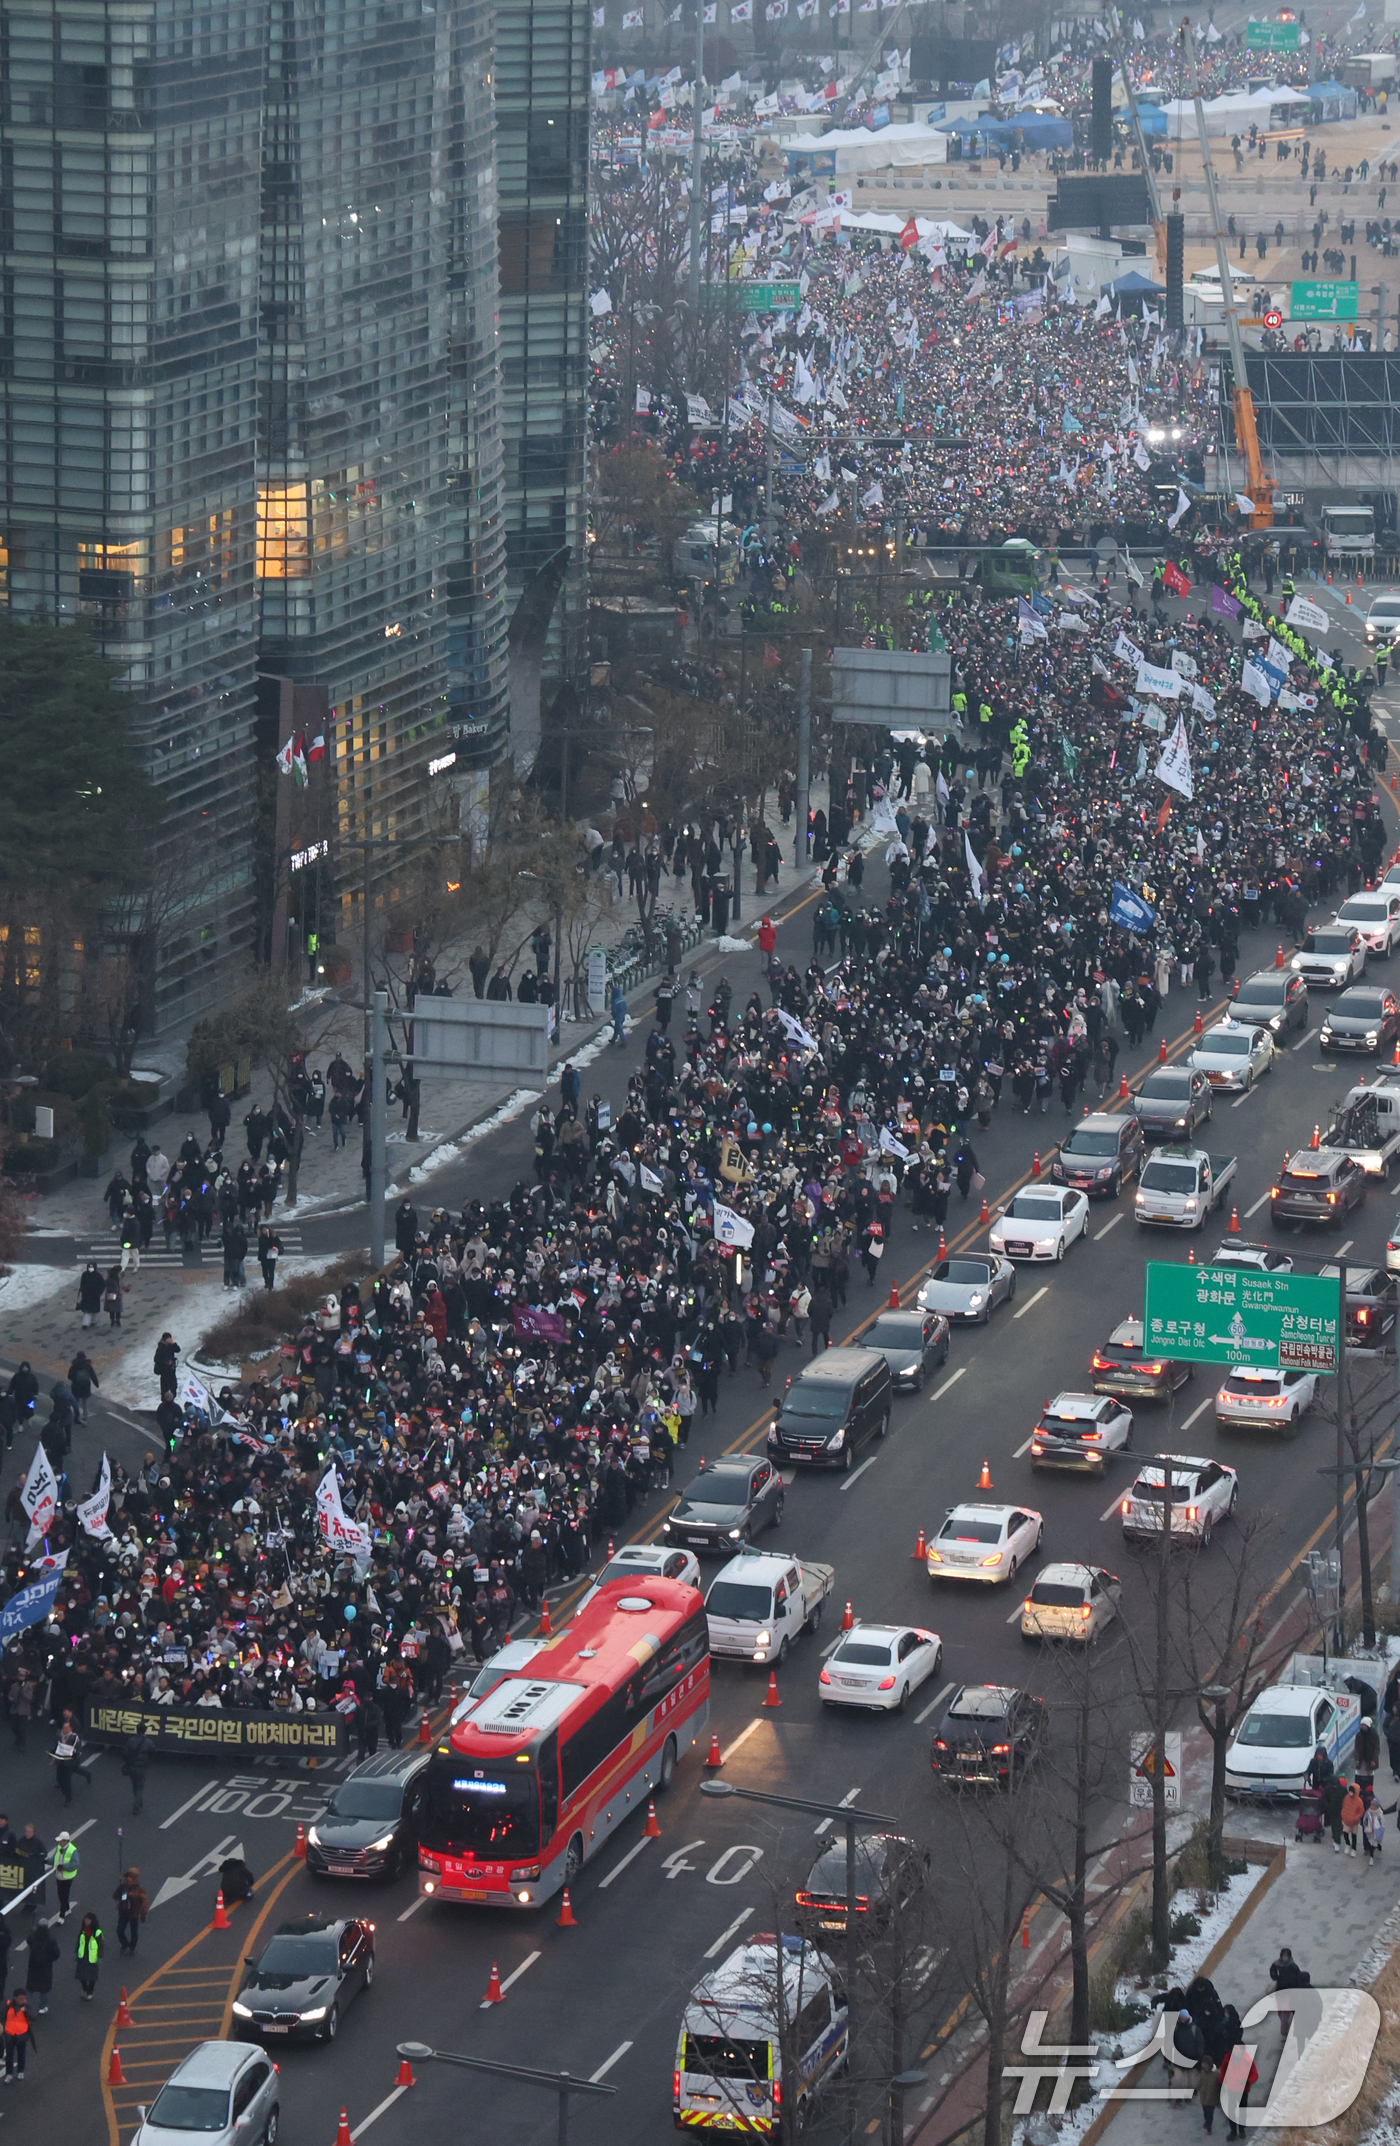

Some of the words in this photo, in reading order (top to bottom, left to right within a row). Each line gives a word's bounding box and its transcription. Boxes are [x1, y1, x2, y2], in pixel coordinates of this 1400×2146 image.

[1268, 316, 1278, 325] 40
[463, 723, 488, 735] Bakery
[1196, 1270, 1237, 1287] 수색역
[1241, 1278, 1272, 1289] Susaek
[1274, 1280, 1289, 1291] Stn
[1196, 1289, 1236, 1306] 광화문
[1241, 1290, 1274, 1302] 光化門
[1241, 1301, 1300, 1314] Gwanghwamun
[1150, 1318, 1206, 1337] 종로구청
[1231, 1325, 1243, 1335] 50
[1281, 1314, 1336, 1333] 삼청터널
[1150, 1335, 1175, 1347] Jongno
[1178, 1336, 1191, 1347] Dist
[1192, 1338, 1206, 1348] Ofc
[1280, 1328, 1315, 1344] Samcheong
[1225, 1350, 1250, 1361] 100m
[1280, 1342, 1333, 1360] 국립민속박물관
[1280, 1357, 1299, 1367] National
[1300, 1358, 1312, 1368] Folk
[1337, 1699, 1348, 1707] SG
[90, 1707, 161, 1736] 내란동조
[164, 1715, 242, 1744] 국민의힘
[246, 1723, 336, 1746] 해체하라!
[660, 1840, 764, 1885] 40
[711, 2119, 736, 2129] POLICE
